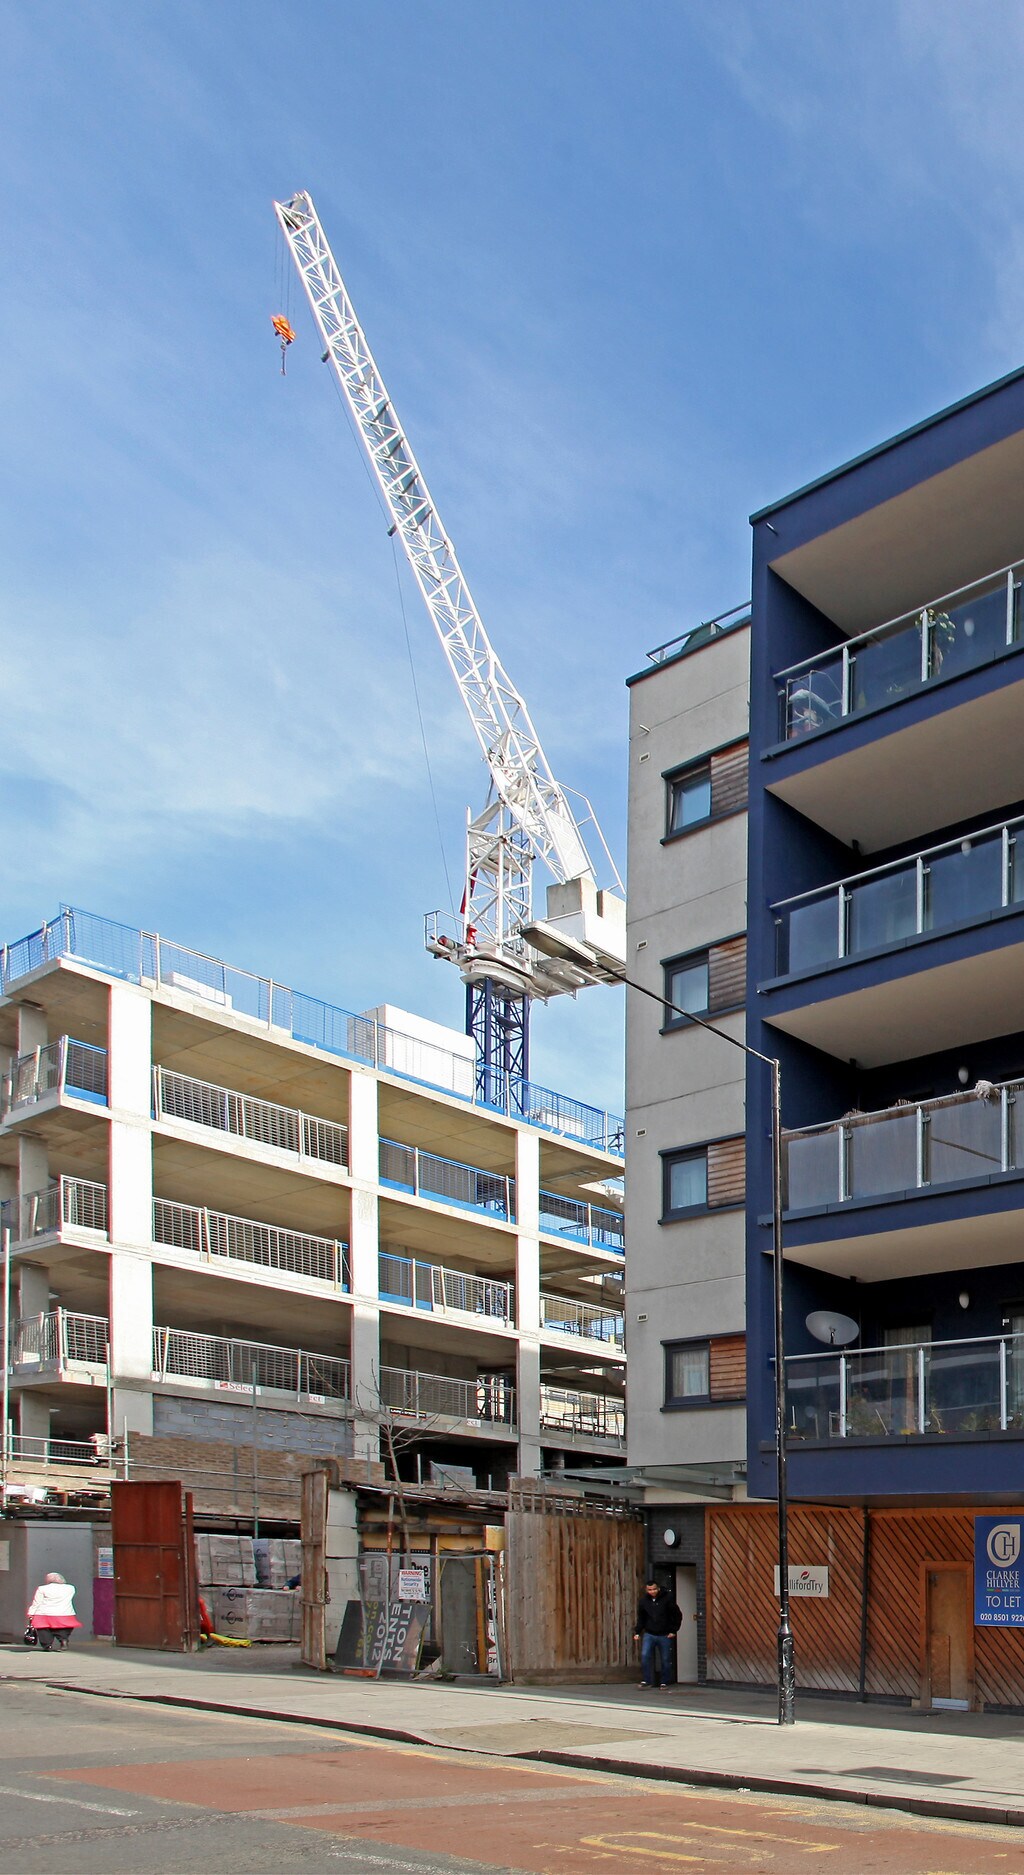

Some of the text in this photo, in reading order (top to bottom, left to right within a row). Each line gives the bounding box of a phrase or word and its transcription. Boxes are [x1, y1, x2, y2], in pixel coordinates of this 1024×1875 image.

[229, 1382, 256, 1393] Selec
[986, 1570, 1020, 1580] CLARKE
[789, 1579, 823, 1594] llifordTry
[986, 1579, 1020, 1588] HILLYER
[986, 1595, 1021, 1608] TO LET
[980, 1613, 992, 1621] 020
[993, 1613, 1009, 1621] 8501
